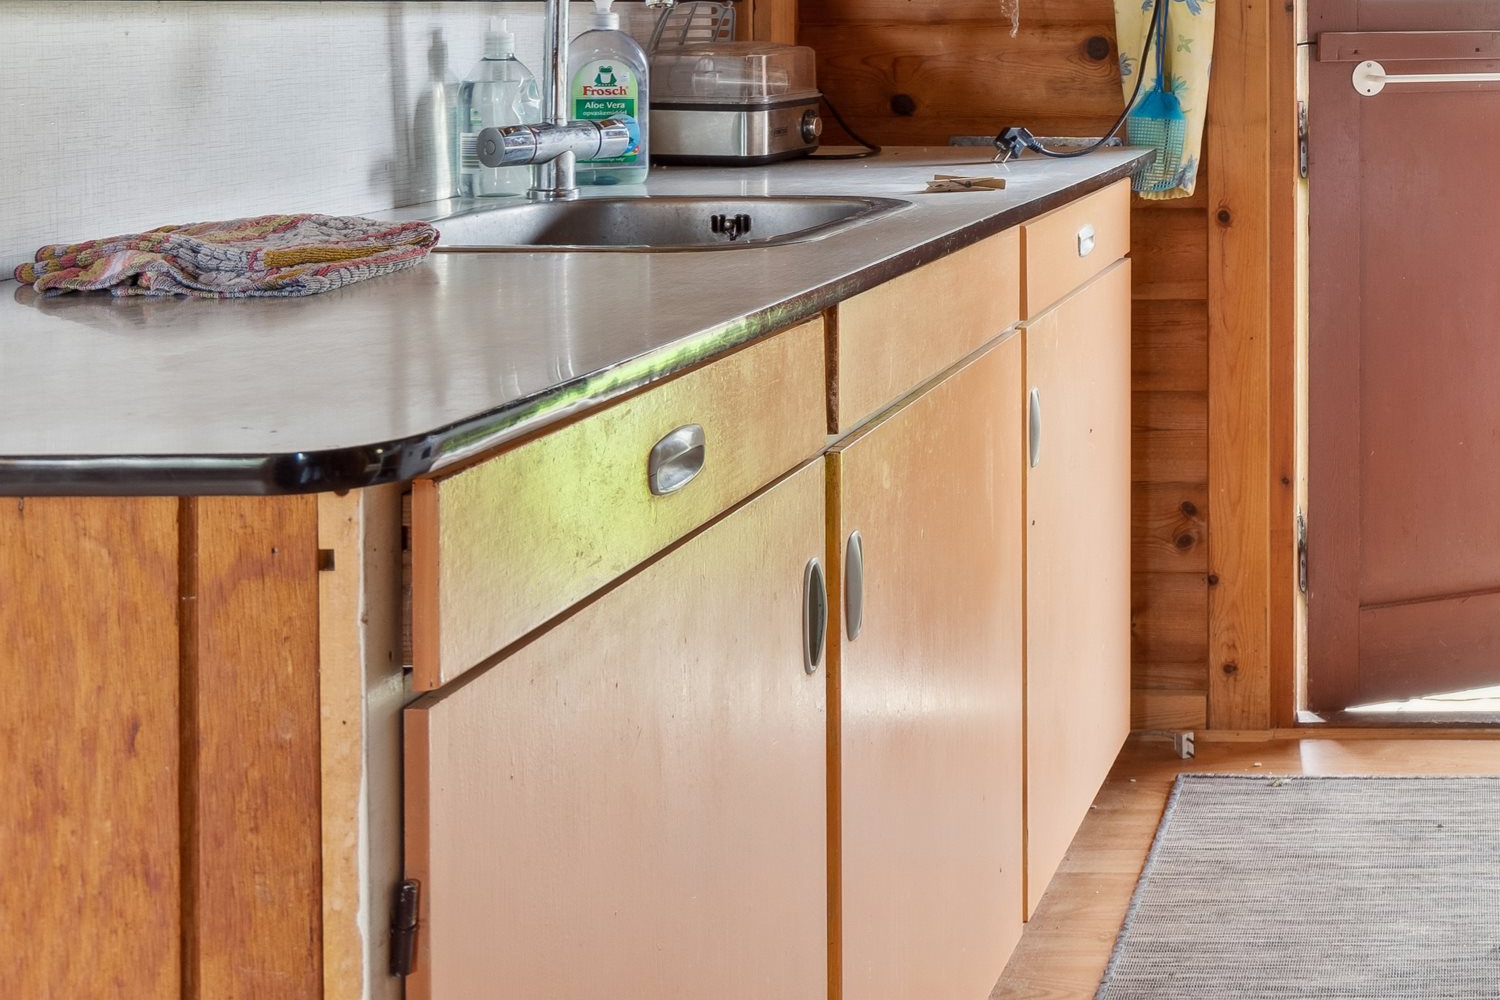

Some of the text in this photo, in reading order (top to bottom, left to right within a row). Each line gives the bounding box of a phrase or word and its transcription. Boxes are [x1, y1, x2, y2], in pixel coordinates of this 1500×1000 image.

[582, 85, 627, 96] Frosch
[584, 101, 626, 110] Aloe Vera
